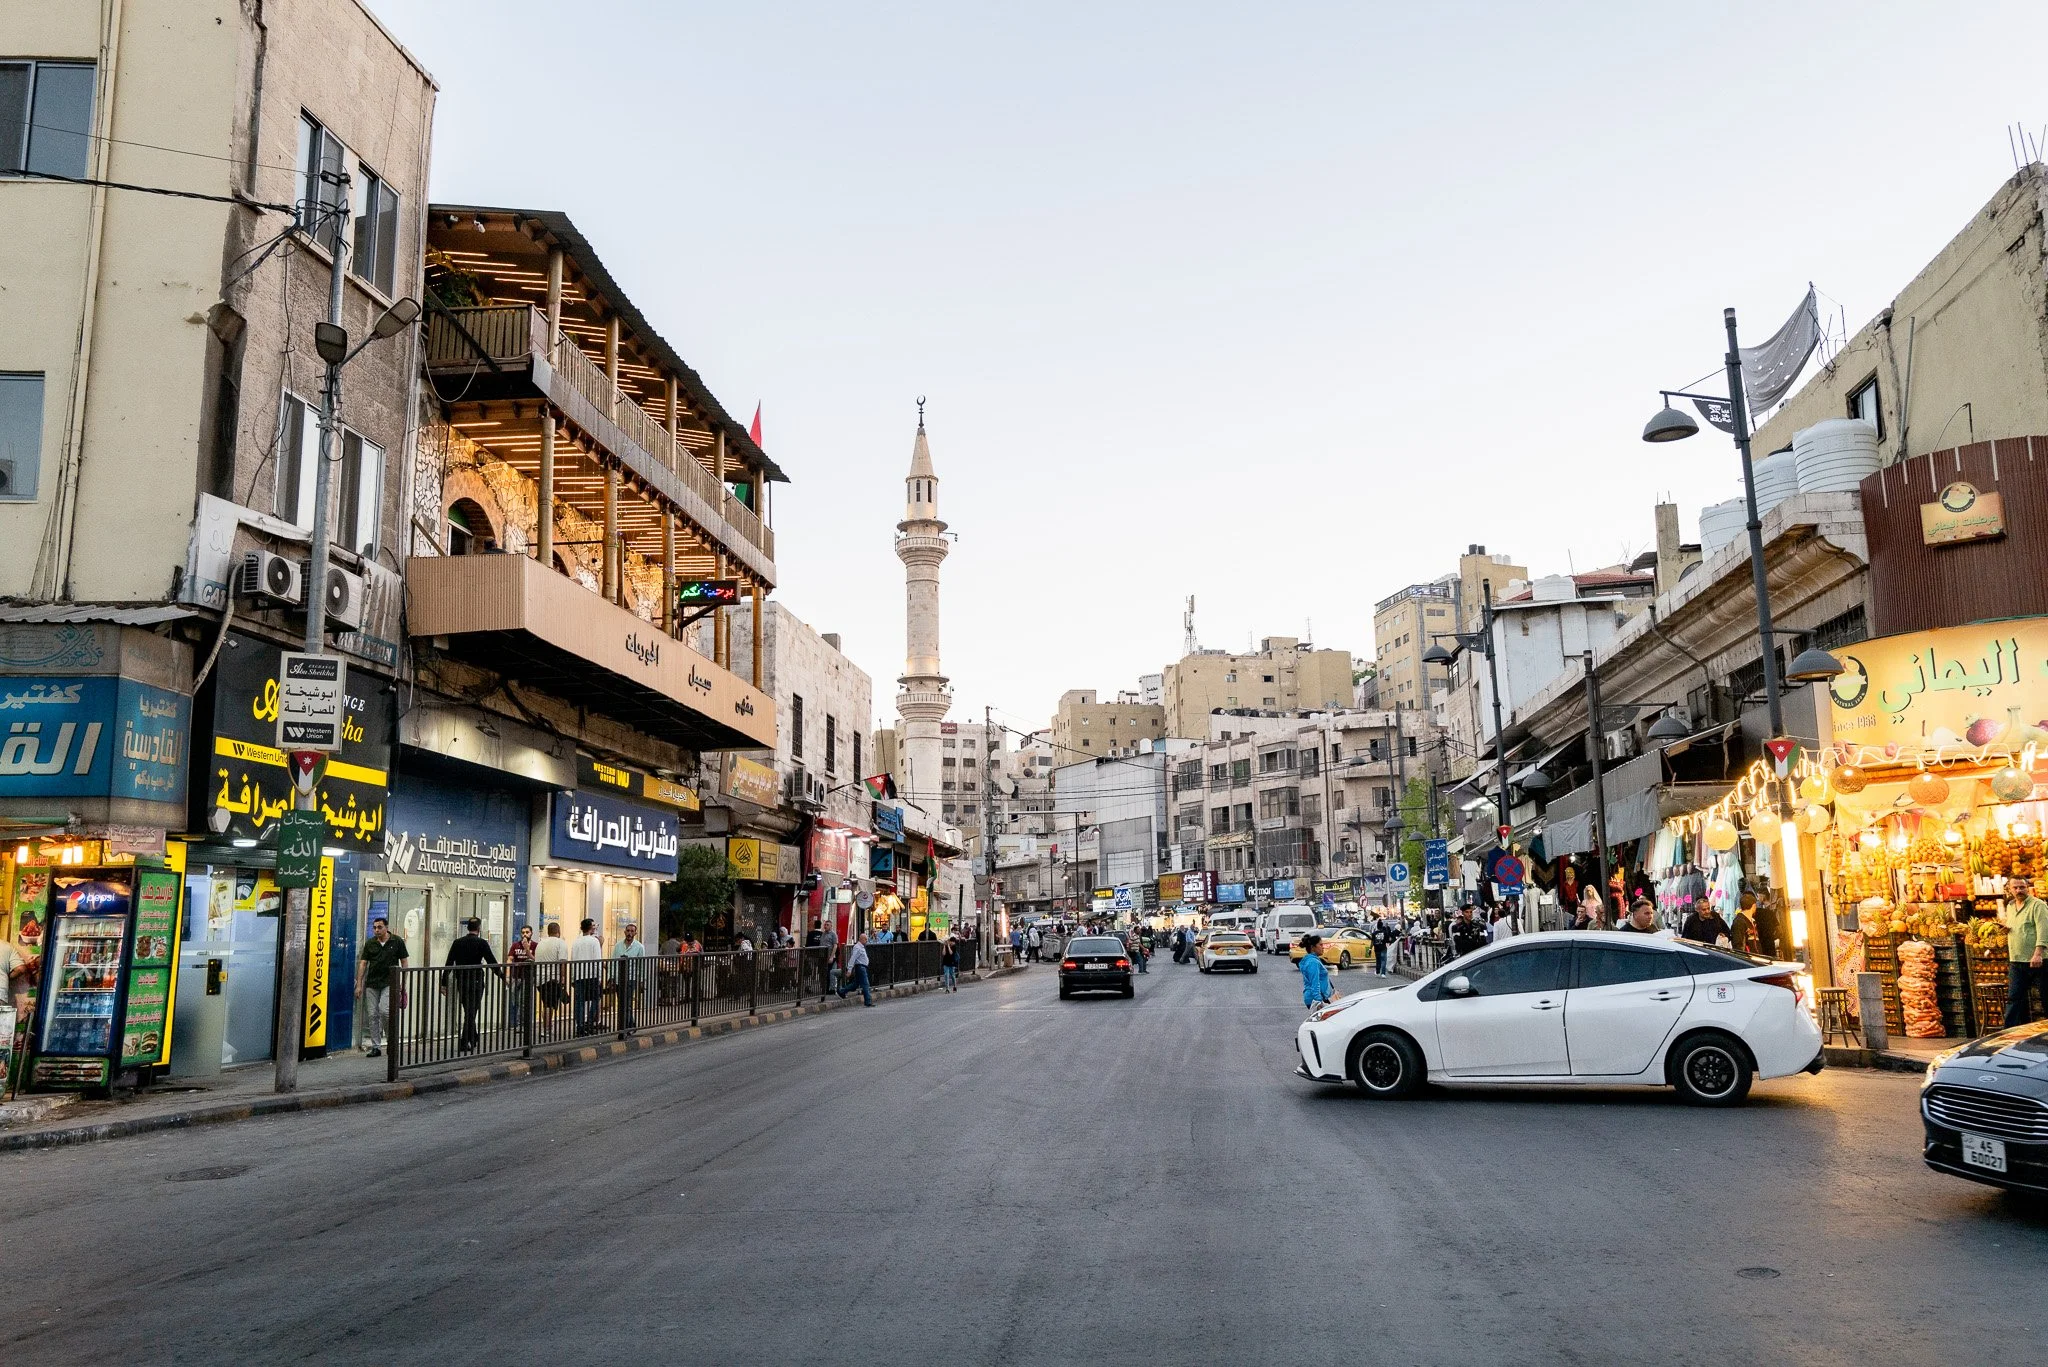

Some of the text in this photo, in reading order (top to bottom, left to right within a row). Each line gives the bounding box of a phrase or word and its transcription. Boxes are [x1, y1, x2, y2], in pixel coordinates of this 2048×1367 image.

[308, 668, 335, 677] Sheikha
[688, 664, 712, 696] سبيل
[1878, 637, 2020, 725] اليماني
[284, 701, 336, 717] للصرافة
[123, 720, 183, 770] القادسية
[246, 746, 274, 762] Western
[593, 762, 616, 776] WESTERN
[599, 772, 616, 785] UNION
[283, 812, 323, 826] سبحان
[569, 805, 630, 851] للصرافة
[283, 831, 317, 857] الله
[418, 832, 517, 865] العلاونة للصرافة
[417, 857, 517, 884] Alawneh Exchange
[86, 891, 116, 903] pepsi
[312, 865, 329, 998] Western Union
[1980, 1140, 1993, 1153] 45
[1971, 1151, 2003, 1169] 60027
